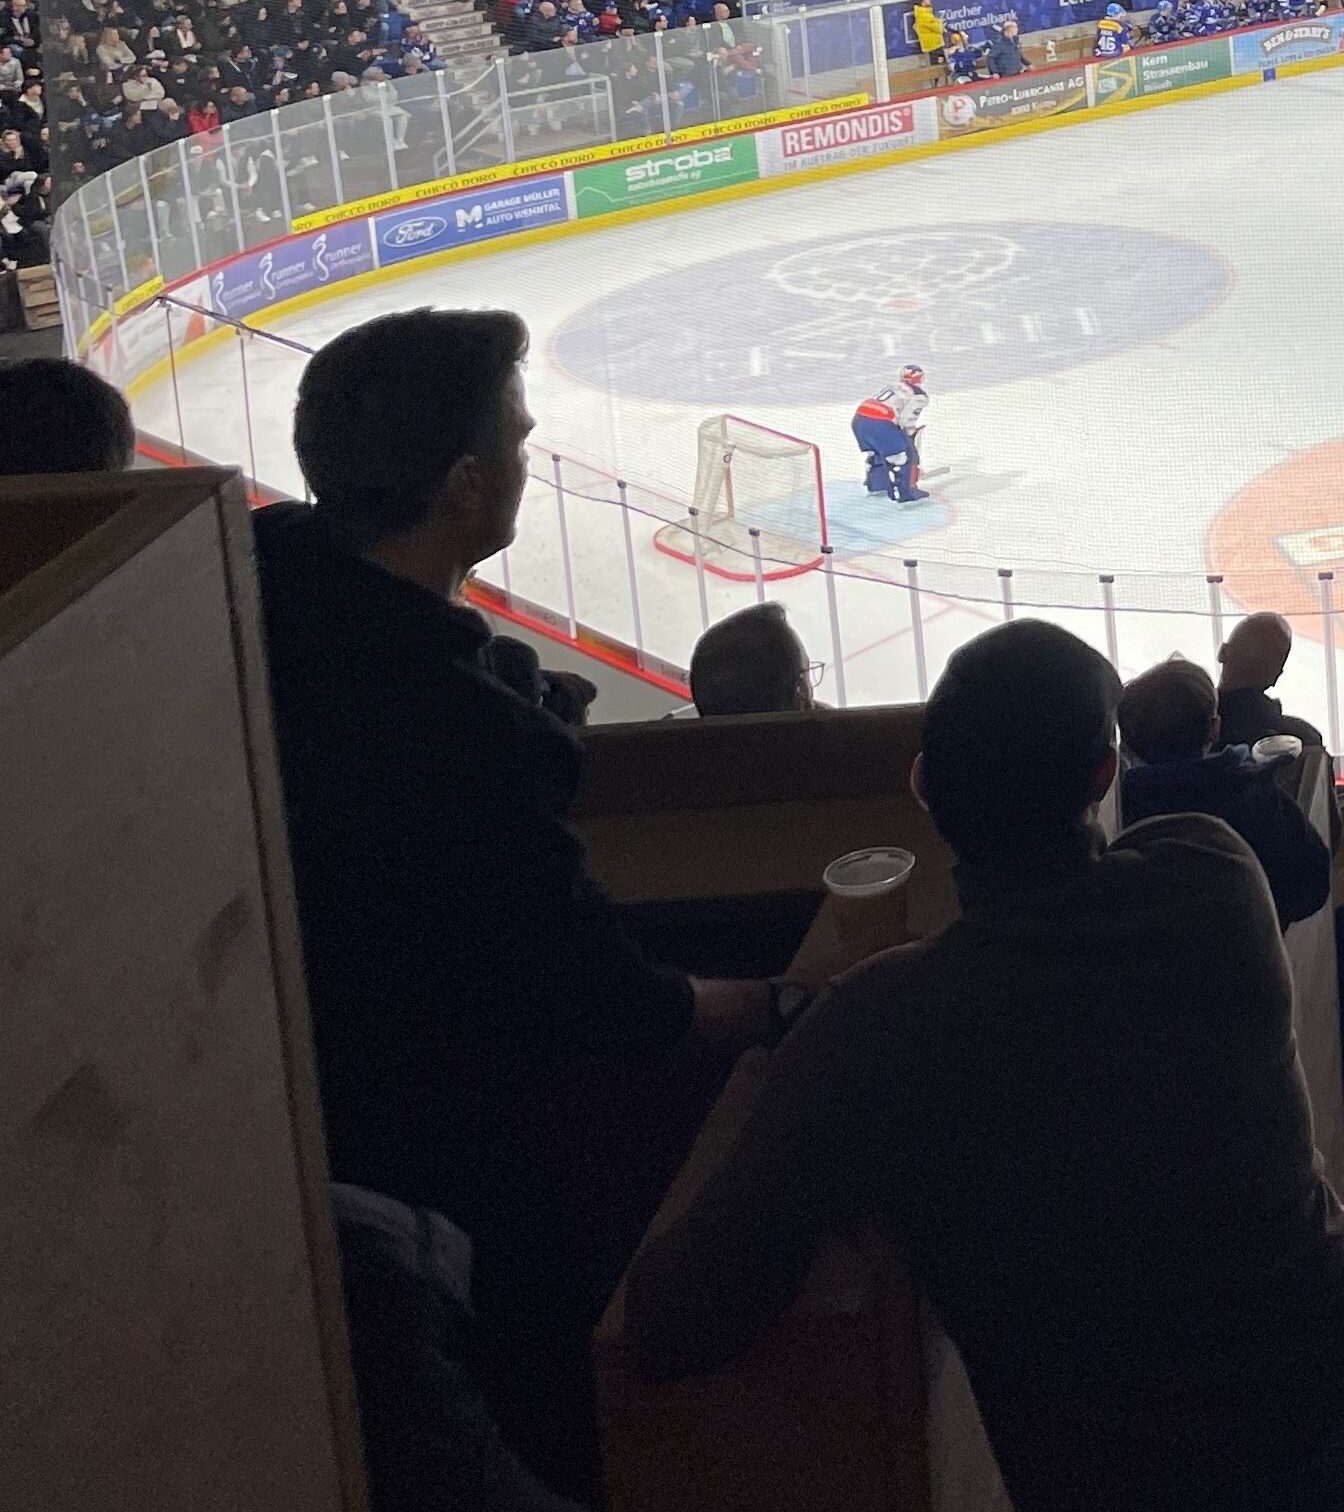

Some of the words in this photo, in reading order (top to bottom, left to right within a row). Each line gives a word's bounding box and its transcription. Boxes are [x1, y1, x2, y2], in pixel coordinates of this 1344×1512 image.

[939, 4, 982, 20] Zürcher
[1098, 36, 1116, 51] 46
[1142, 54, 1168, 67] Kern
[1143, 59, 1208, 81] Strassenbau
[1068, 77, 1084, 88] AG
[790, 105, 829, 120] CHICCO
[701, 122, 742, 137] CHICCO
[784, 112, 903, 155] REMONDIS
[610, 142, 653, 156] CHICCO
[625, 144, 733, 182] stroba
[784, 160, 798, 171] IM
[800, 151, 846, 169] AUFTRAG
[851, 145, 870, 159] DER
[513, 160, 558, 176] CHICCO
[415, 181, 458, 198] CHICCO
[484, 196, 521, 211] GARAGE
[523, 188, 560, 204] MÜLLER
[325, 205, 366, 223] CHICCO
[485, 211, 513, 226] AUTO
[514, 203, 562, 219] WEHNTAL
[396, 222, 434, 243] Ford
